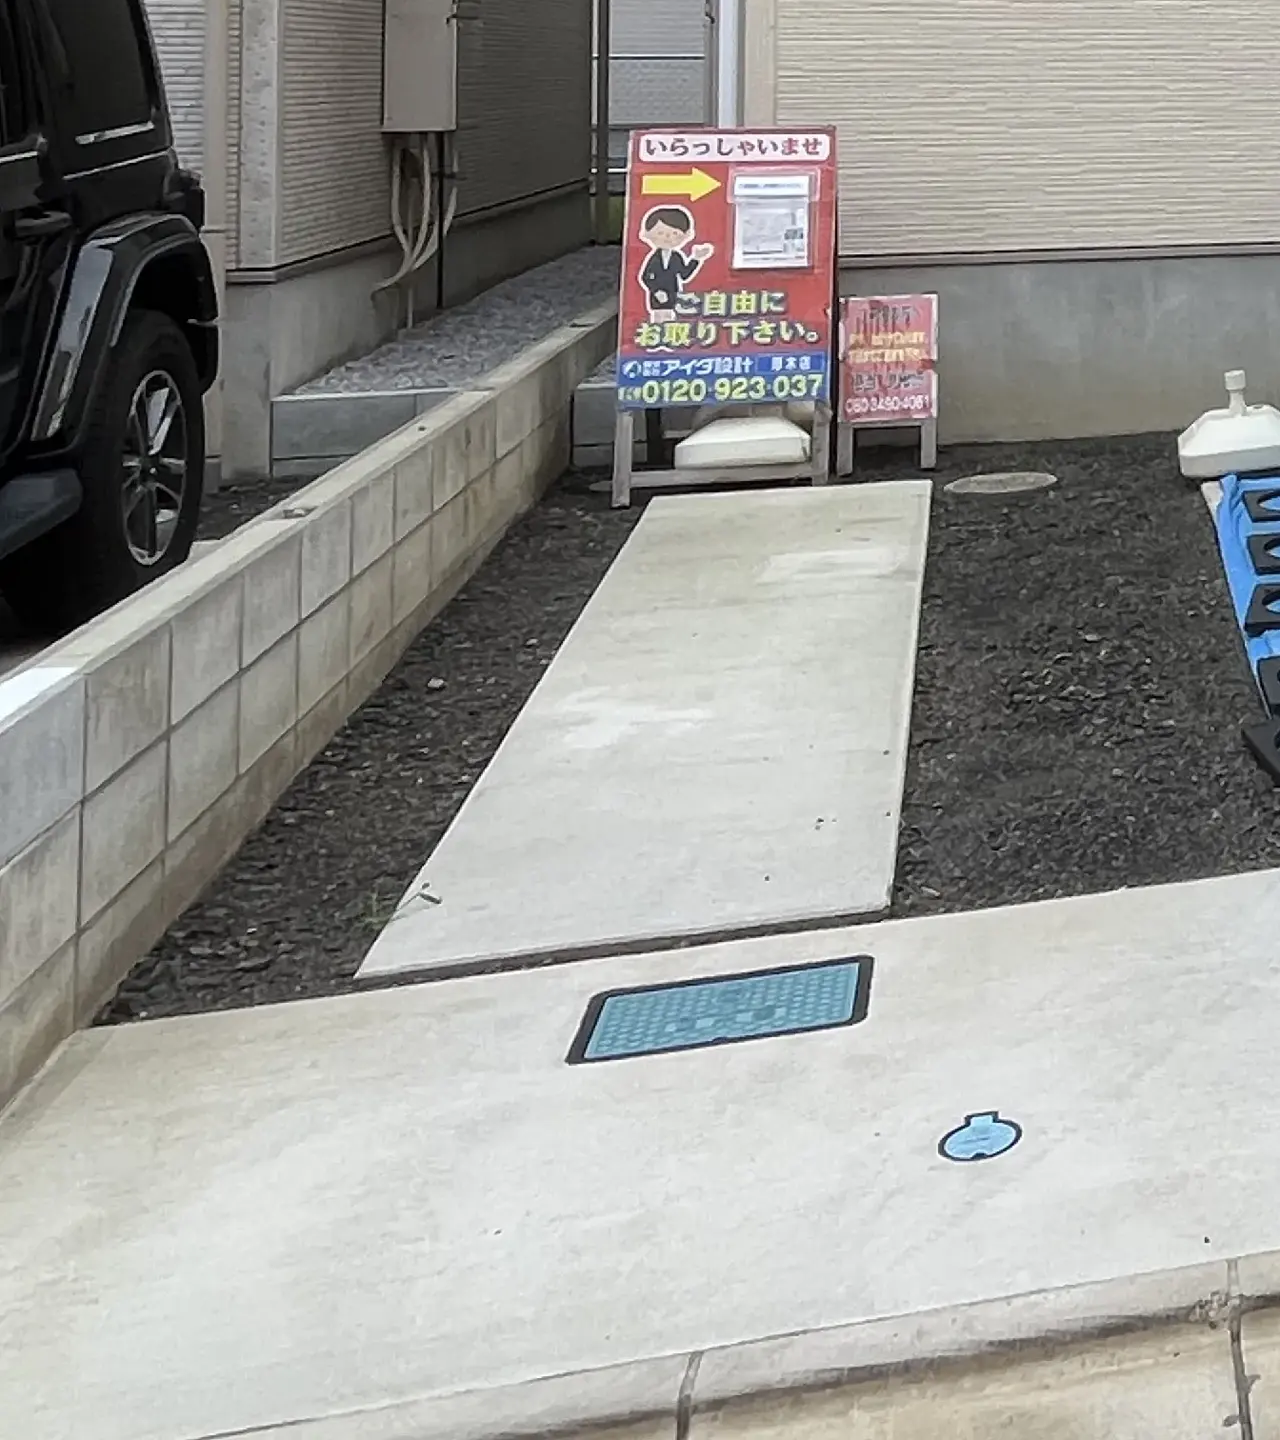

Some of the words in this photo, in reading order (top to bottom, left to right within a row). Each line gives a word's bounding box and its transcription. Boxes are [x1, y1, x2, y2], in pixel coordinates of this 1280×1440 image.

[645, 136, 823, 157] いらっしゃいませ
[675, 290, 785, 316] ご自由に
[635, 320, 820, 346] お取り下さい。
